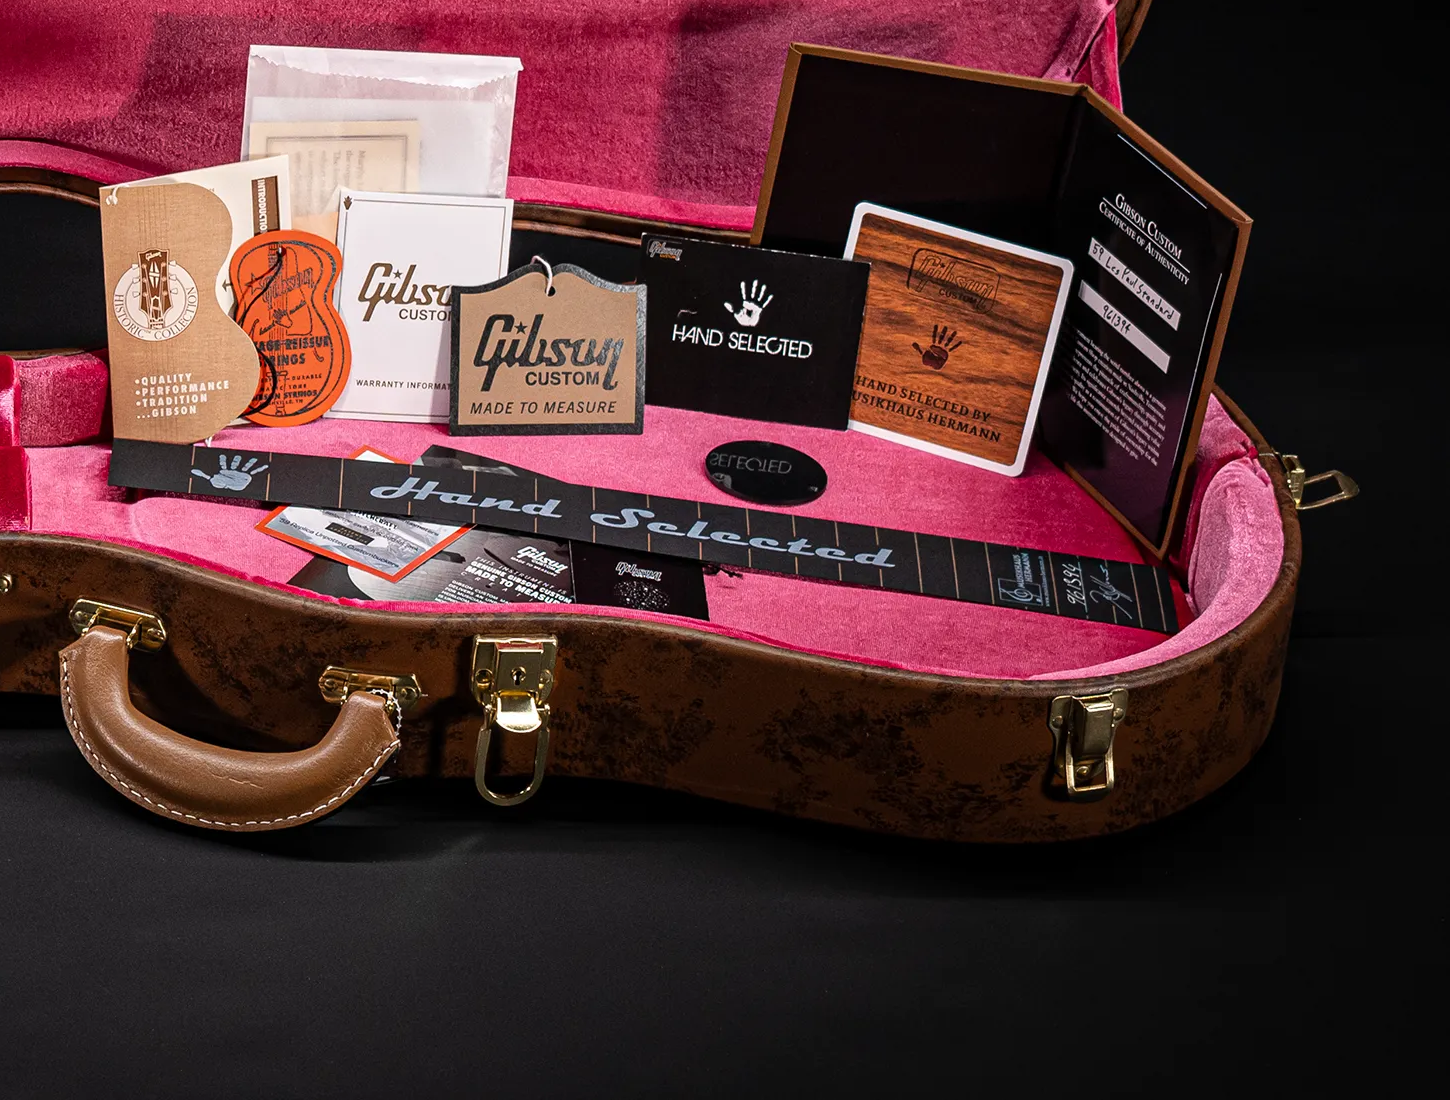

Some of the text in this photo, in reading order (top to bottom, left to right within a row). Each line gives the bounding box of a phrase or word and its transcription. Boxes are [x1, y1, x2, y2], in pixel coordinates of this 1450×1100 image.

[257, 179, 268, 233] INTRODUCTIO
[916, 255, 993, 310] Gibson
[1105, 256, 1120, 275] Les
[1121, 267, 1139, 289] Paul
[1136, 284, 1175, 320] Standard
[154, 287, 197, 340] COLLECTION
[399, 308, 451, 321] CUSTO
[473, 314, 624, 392] Gibson
[672, 324, 813, 359] HAND SELECTED
[141, 373, 192, 386] QUALITY
[142, 380, 229, 396] PERFORMANCE
[356, 379, 404, 389] WARRANTY
[525, 371, 600, 386] CUSTOM
[142, 394, 207, 408] TRADITION
[470, 400, 617, 415] MADE TO MEASURE
[856, 375, 991, 422] HAND SELECTED BY
[852, 390, 1001, 442] USIKHAUS HERMANN
[369, 477, 895, 568] Hand Selected
[465, 565, 498, 582] MADE
[499, 577, 514, 587] TO
[475, 556, 495, 566] THIS
[498, 565, 555, 589] INSTRUMENT
[517, 546, 568, 574] Gibson
[471, 561, 573, 605] GENUINE GIBSON CUSTOM
